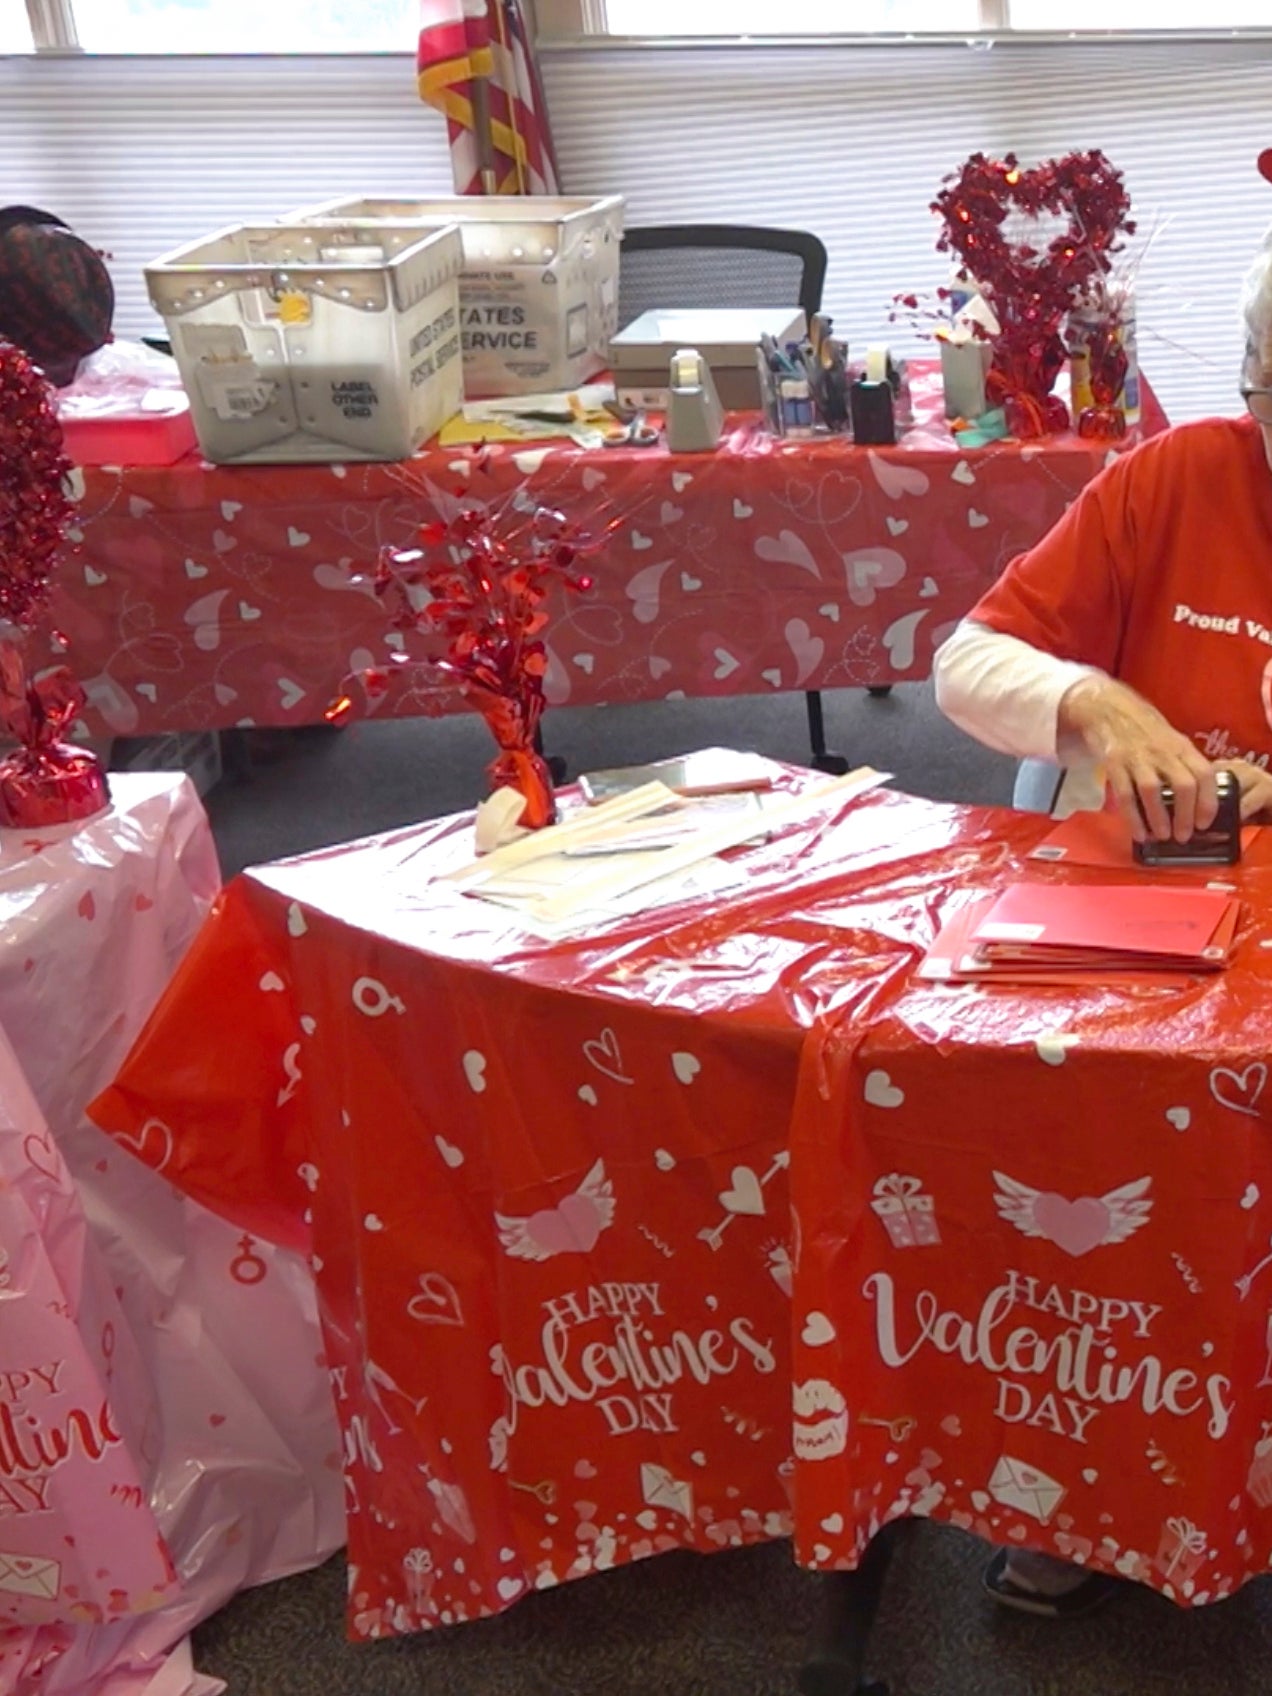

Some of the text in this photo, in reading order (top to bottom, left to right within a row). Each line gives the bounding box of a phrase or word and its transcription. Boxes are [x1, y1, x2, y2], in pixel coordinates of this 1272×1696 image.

[460, 306, 525, 326] TATES
[461, 331, 538, 350] ERVICE
[1173, 603, 1241, 635] Proud
[541, 1281, 666, 1332] HAPPY
[1005, 1269, 1163, 1338] HAPPY
[862, 1271, 1236, 1440] Valentine's
[994, 1378, 1100, 1444] DAY
